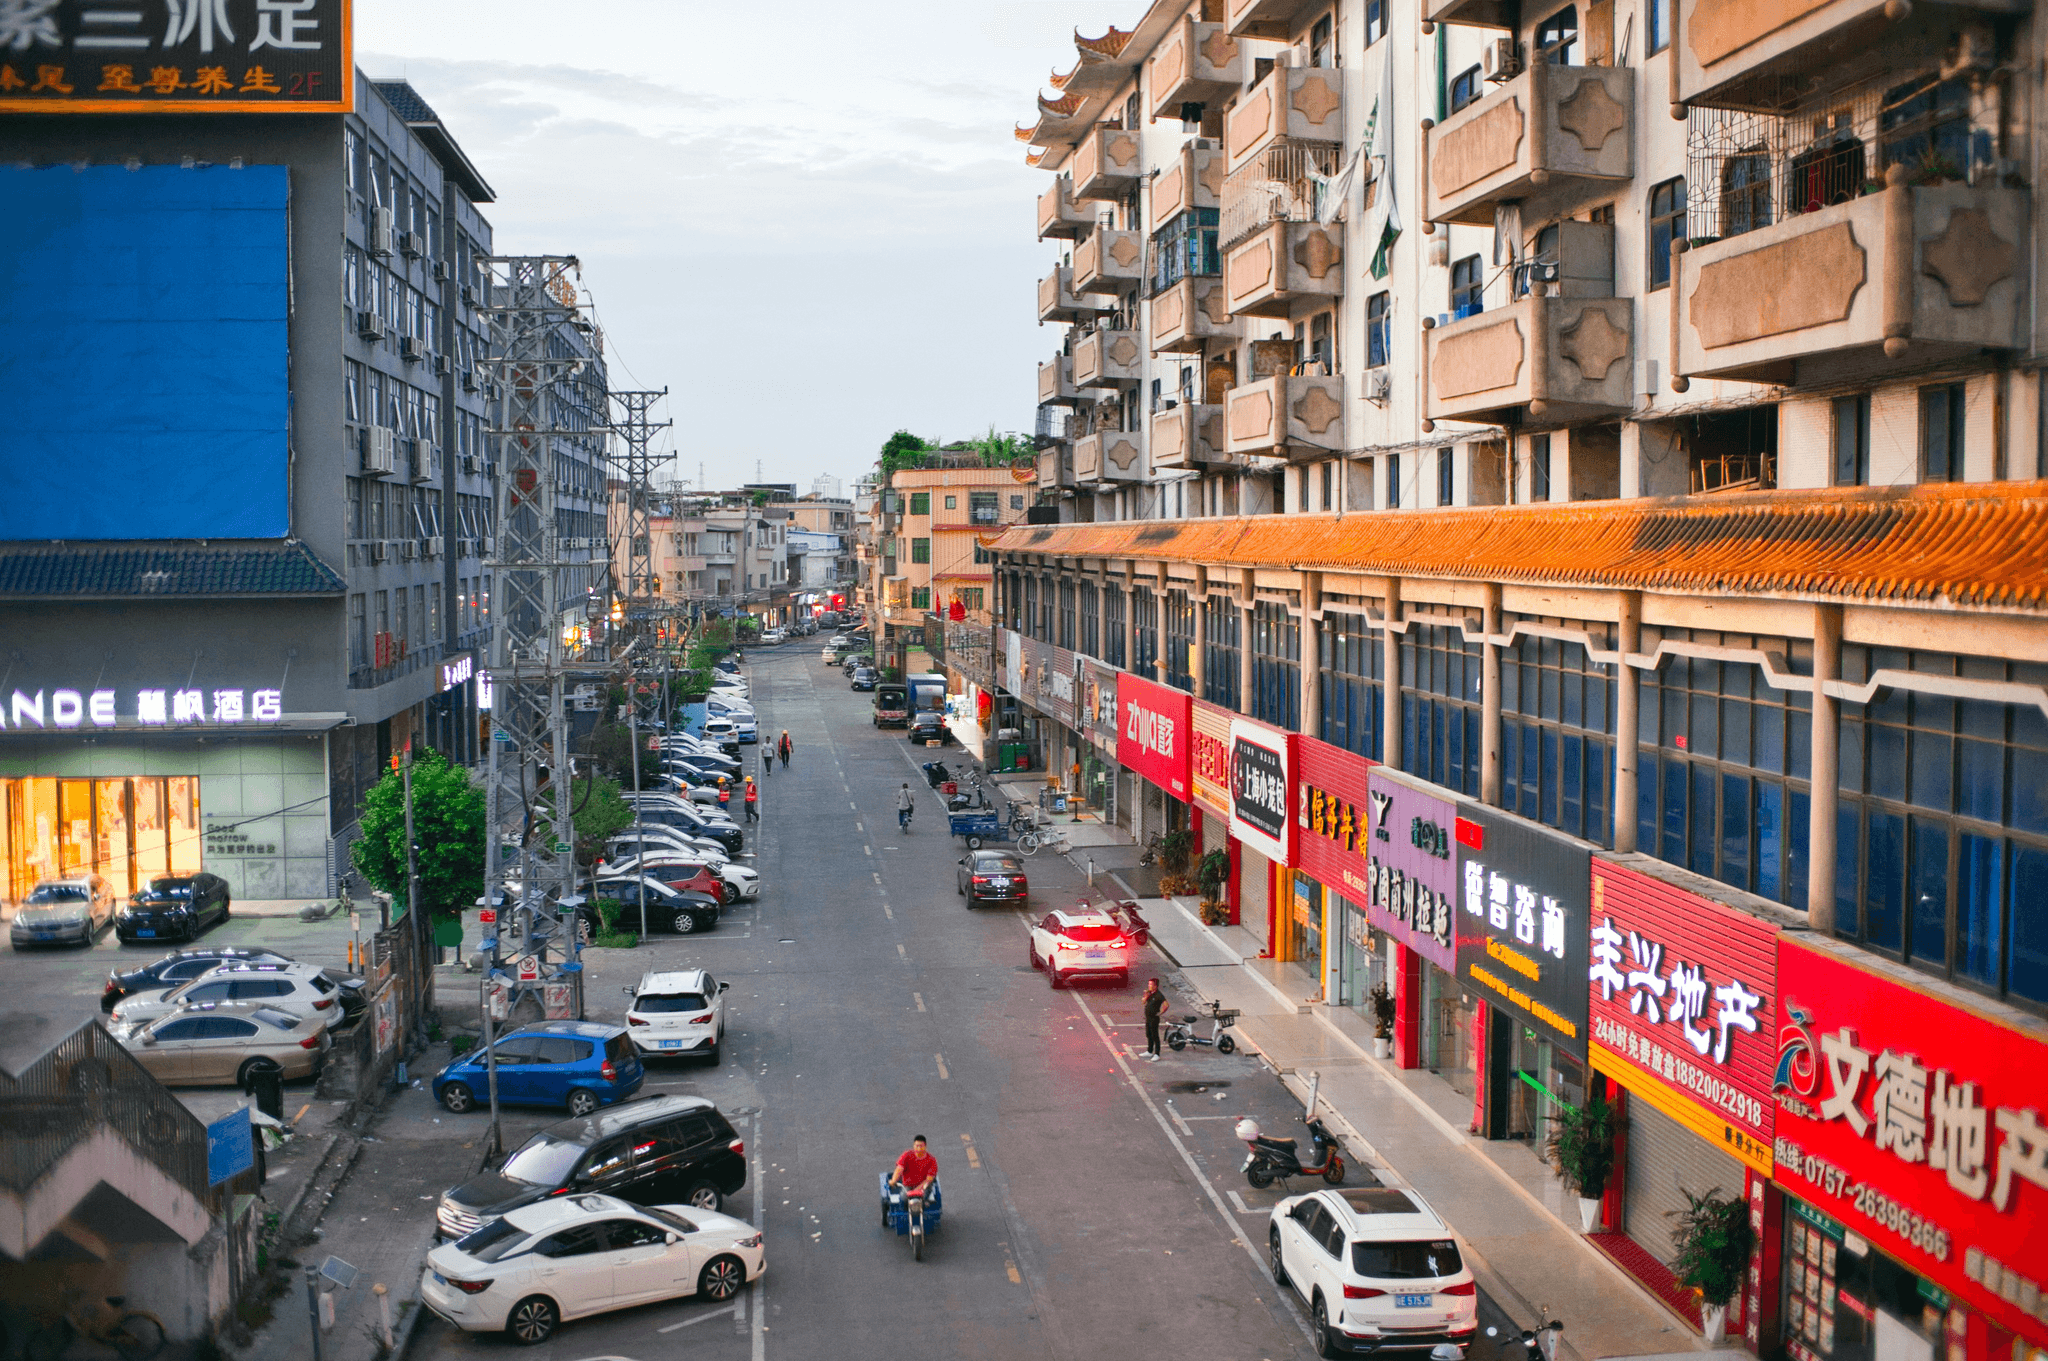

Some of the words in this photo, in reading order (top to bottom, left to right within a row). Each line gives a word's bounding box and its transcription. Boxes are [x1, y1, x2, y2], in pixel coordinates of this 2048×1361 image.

[97, 64, 281, 94] 至尊养生
[289, 72, 322, 95] 2F
[0, 688, 116, 729] NDE
[1589, 917, 1761, 1065] 丰兴地产
[1820, 1027, 2048, 1213] 文德地产
